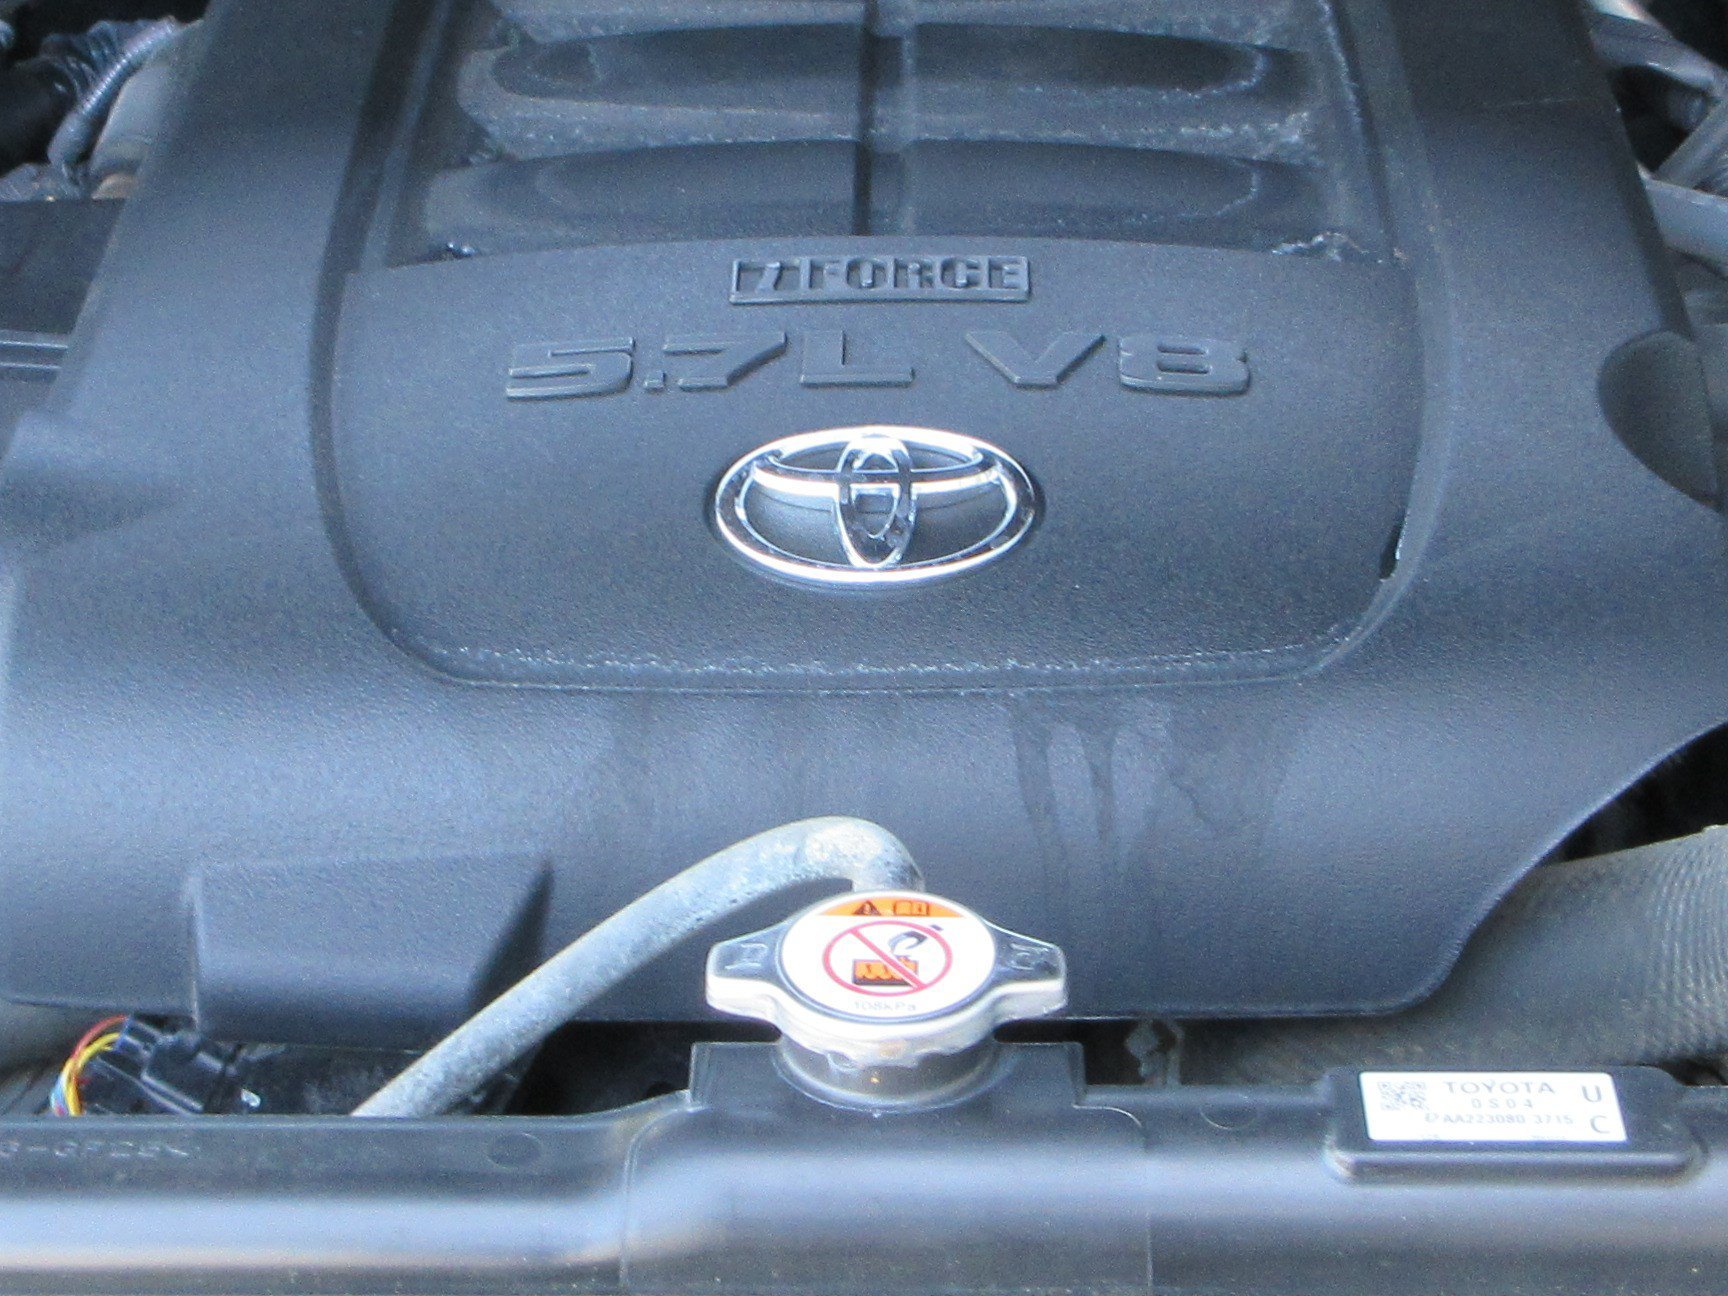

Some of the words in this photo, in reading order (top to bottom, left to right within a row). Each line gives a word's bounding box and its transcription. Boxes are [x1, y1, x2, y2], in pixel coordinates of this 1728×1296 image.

[504, 329, 914, 400] 5.7L
[964, 330, 1253, 396] V8
[1442, 1080, 1555, 1095] TOYOTA
[1581, 1084, 1603, 1103] U
[1589, 1114, 1610, 1134] C
